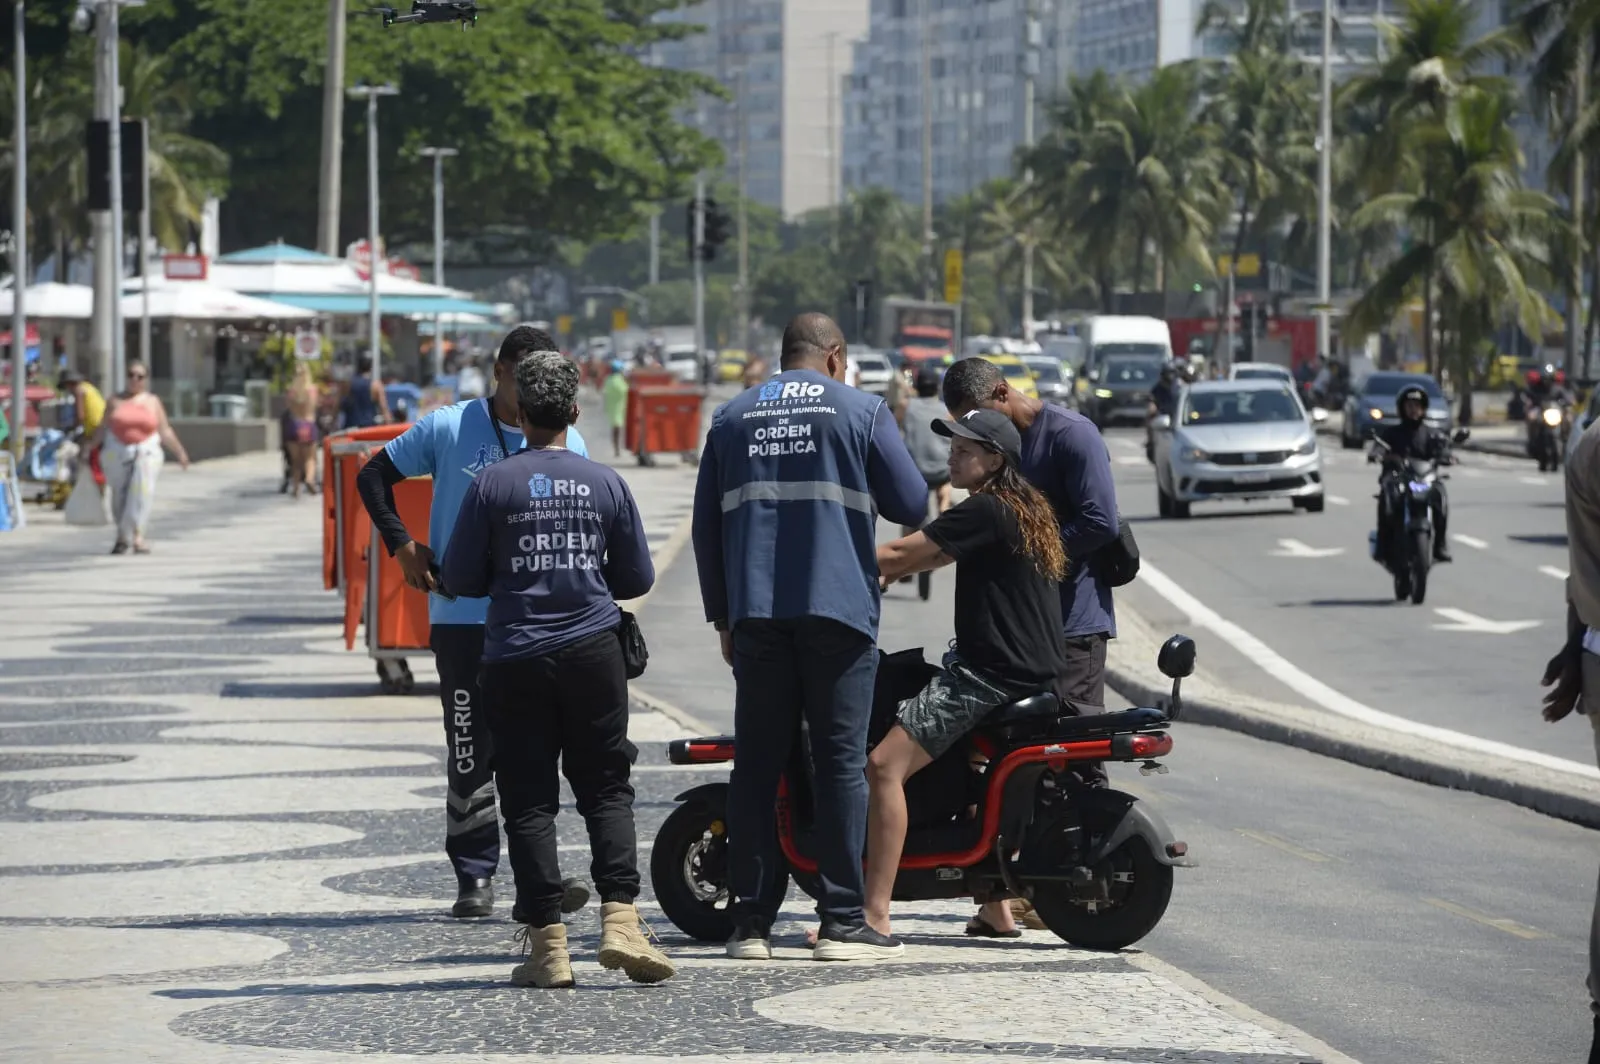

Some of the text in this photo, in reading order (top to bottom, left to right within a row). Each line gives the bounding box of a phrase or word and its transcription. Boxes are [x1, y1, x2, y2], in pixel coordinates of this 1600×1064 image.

[782, 381, 824, 398] Rio
[755, 398, 821, 407] PREFEITURA
[742, 406, 837, 418] SECRETARIA MUNICIPAL
[754, 424, 811, 440] ORDEM
[748, 440, 817, 457] PÚBLICA
[553, 479, 590, 496] Rio
[529, 499, 591, 508] PREFEITURA
[507, 510, 603, 523] SECRETARIA MUNICIPAL
[554, 521, 567, 530] DE
[518, 532, 597, 552] ORDEM
[511, 551, 599, 573] PÚBLICA
[454, 689, 475, 774] CET-RIO
